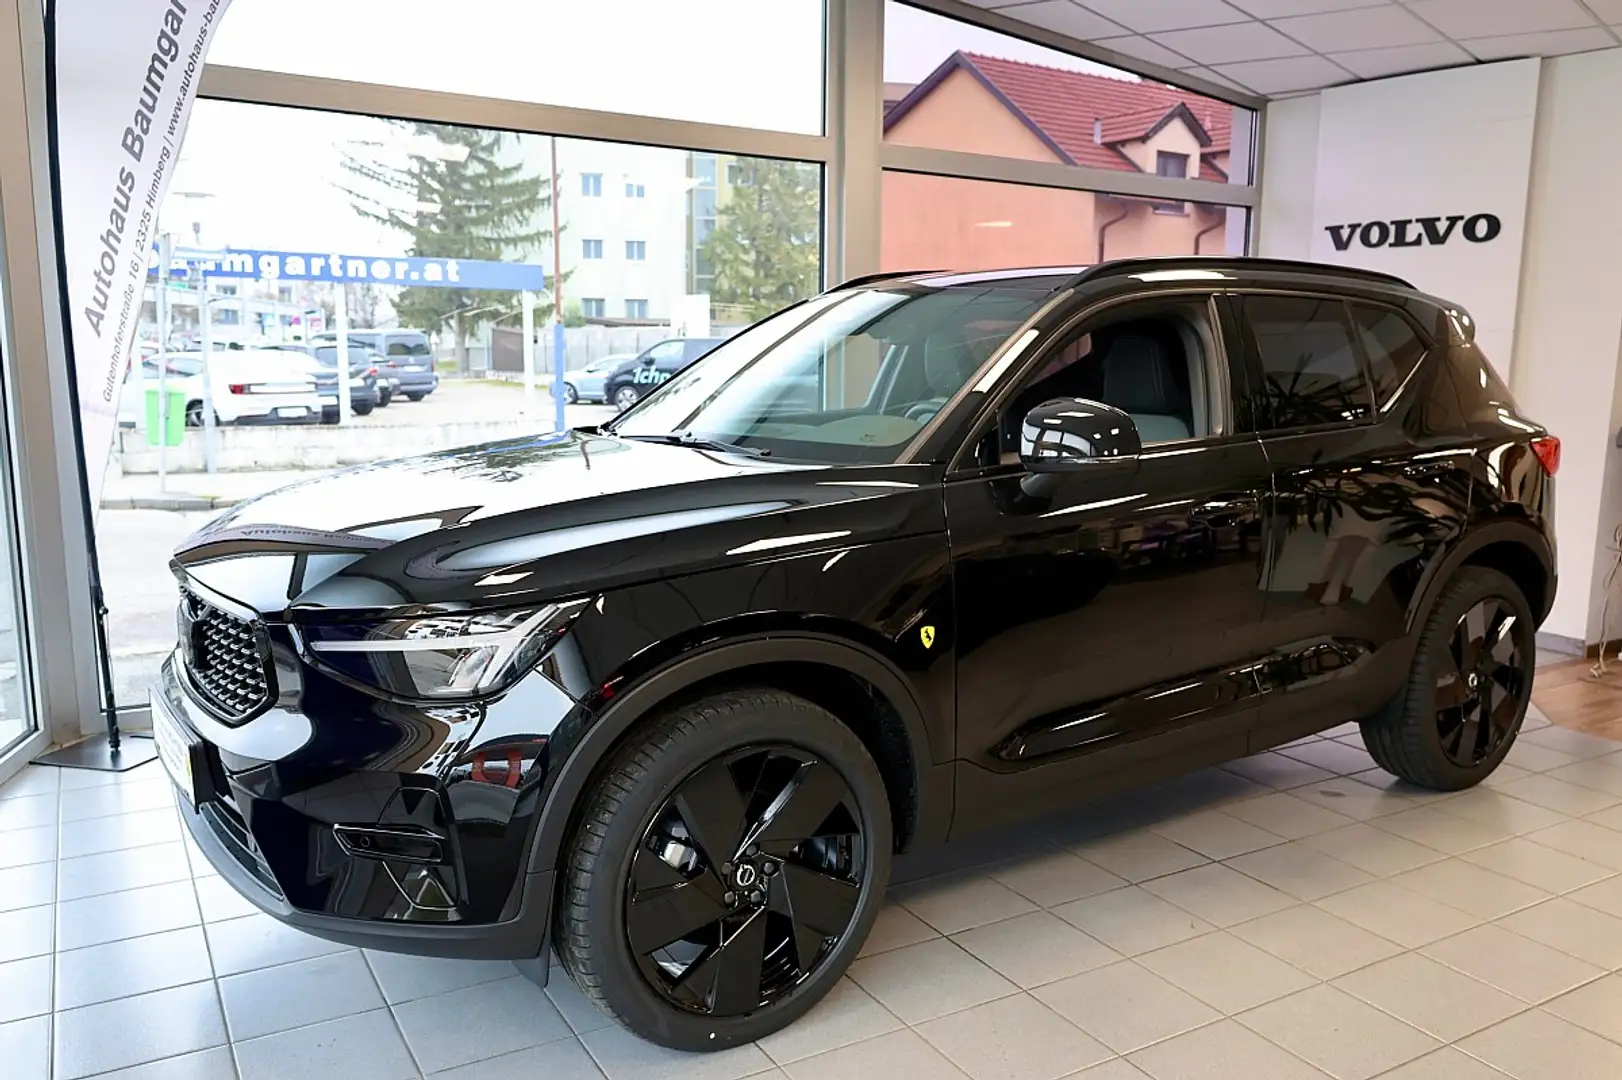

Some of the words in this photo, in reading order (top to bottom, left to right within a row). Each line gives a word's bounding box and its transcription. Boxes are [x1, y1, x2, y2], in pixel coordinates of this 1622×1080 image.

[84, 166, 135, 339] Autohaus
[128, 259, 140, 281] 16
[135, 208, 151, 252] 2325
[145, 146, 172, 209] Himberg
[1324, 213, 1501, 251] VOLVO
